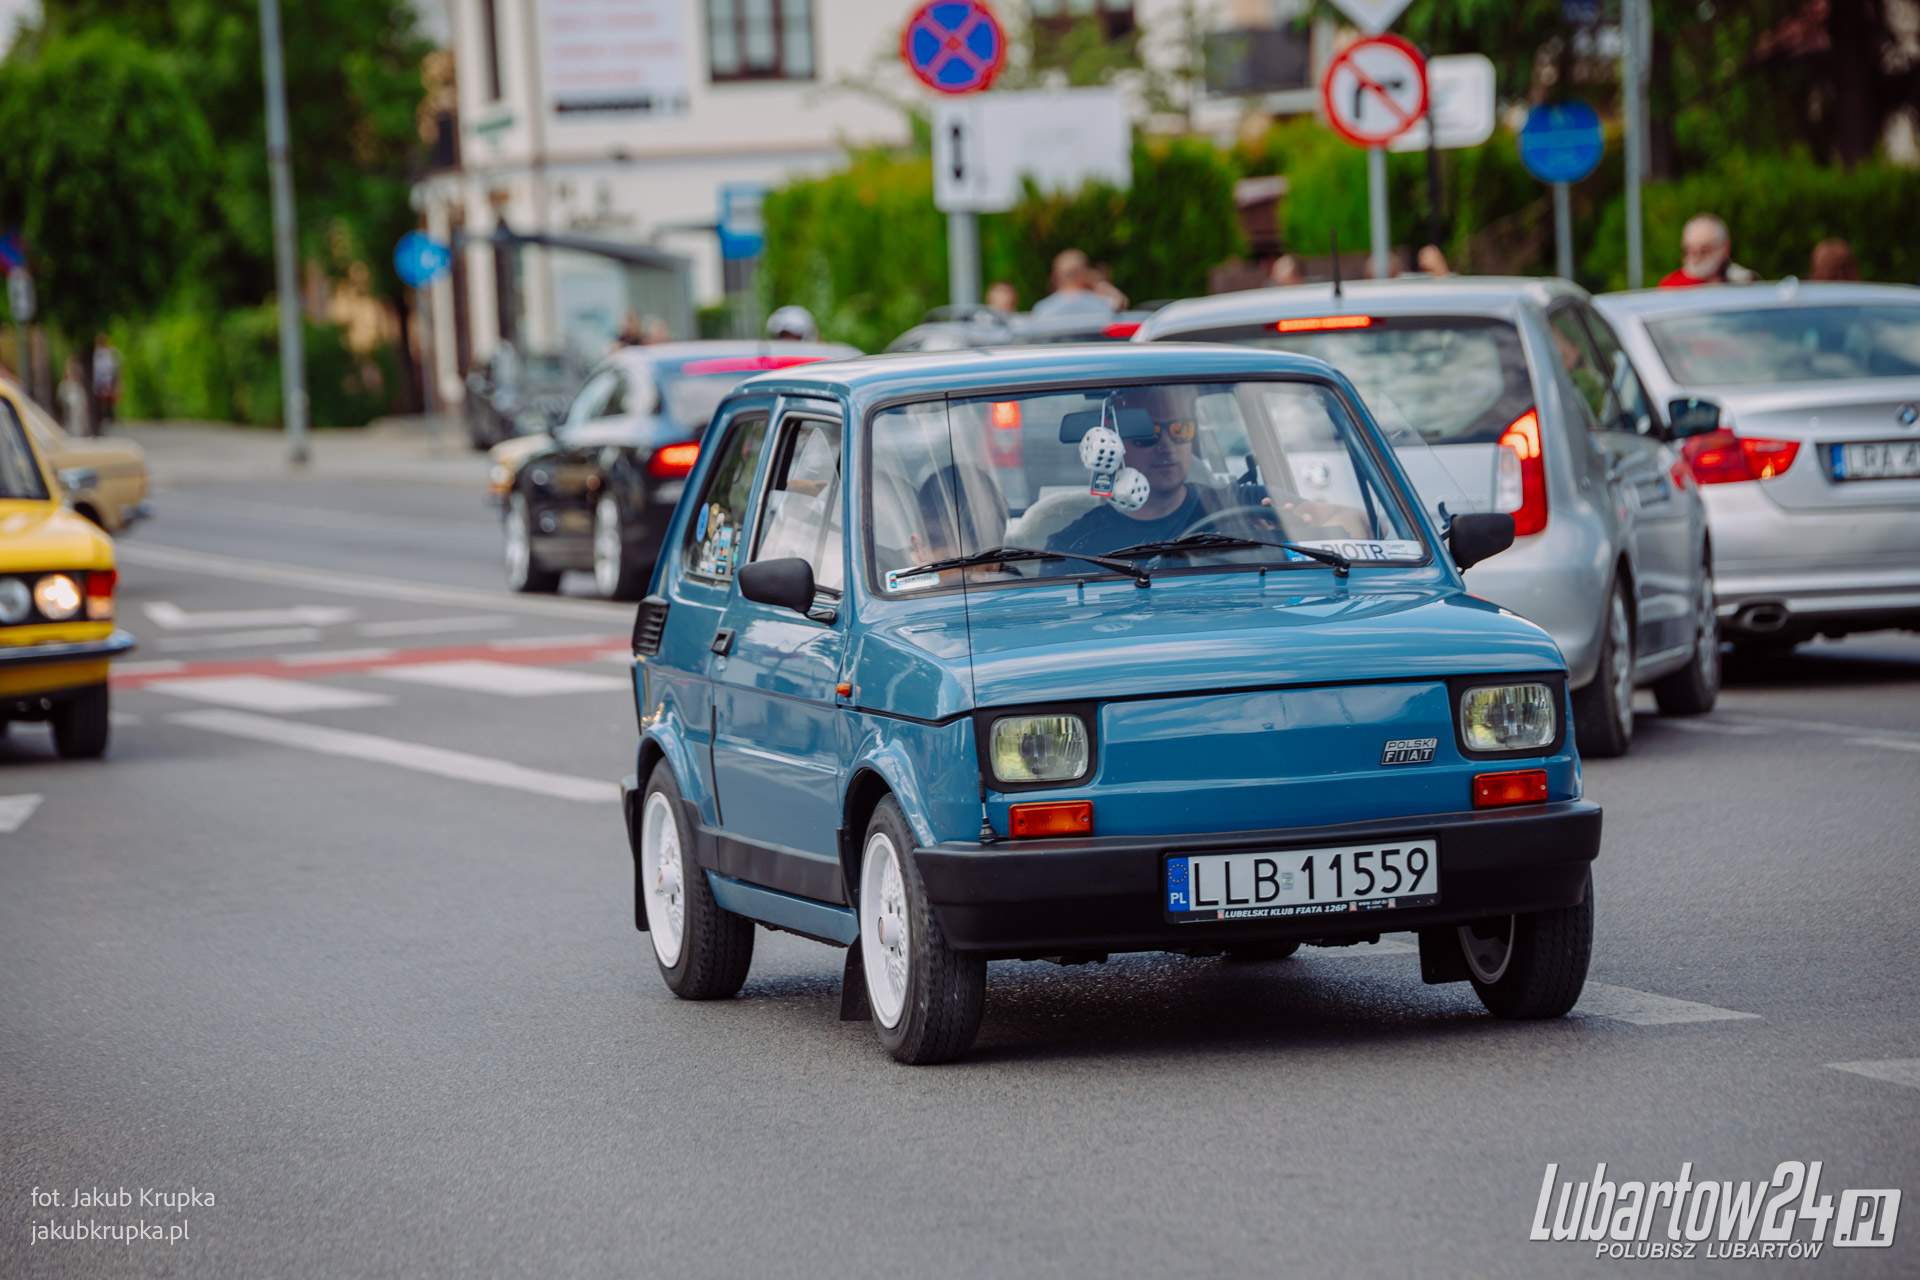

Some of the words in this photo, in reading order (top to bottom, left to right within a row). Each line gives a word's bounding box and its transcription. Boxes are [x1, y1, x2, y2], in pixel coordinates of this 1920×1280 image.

[1387, 740, 1435, 749] POLSKI
[1384, 750, 1432, 762] FIAT
[1194, 858, 1280, 907] LLB
[1300, 847, 1429, 900] 11559
[1170, 892, 1187, 905] PL
[1225, 909, 1269, 918] LUBELSKI
[1270, 907, 1294, 916] KLUB
[1296, 905, 1323, 914] FIATA
[1324, 903, 1347, 913] 126P
